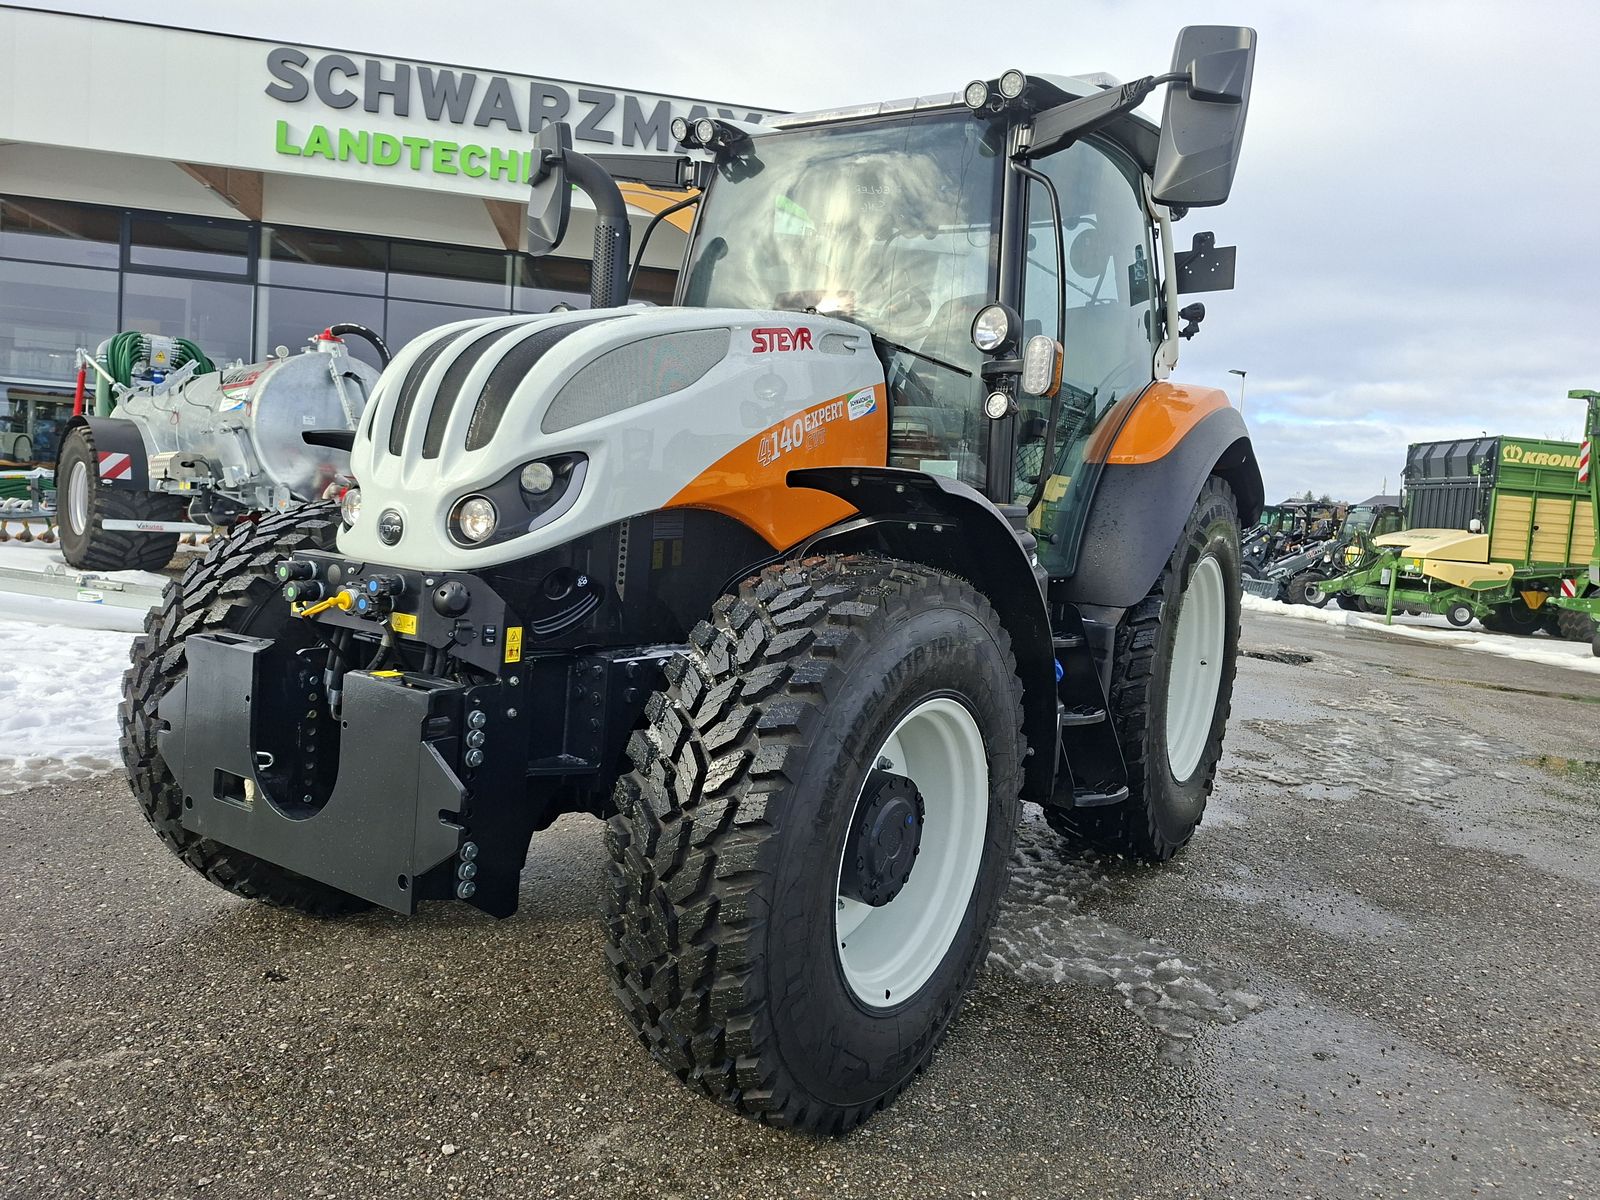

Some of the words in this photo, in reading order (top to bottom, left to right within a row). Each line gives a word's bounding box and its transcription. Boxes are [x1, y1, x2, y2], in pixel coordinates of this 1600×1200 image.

[751, 327, 814, 353] STEYR
[805, 400, 844, 432] EXPERT
[806, 428, 827, 450] CVT
